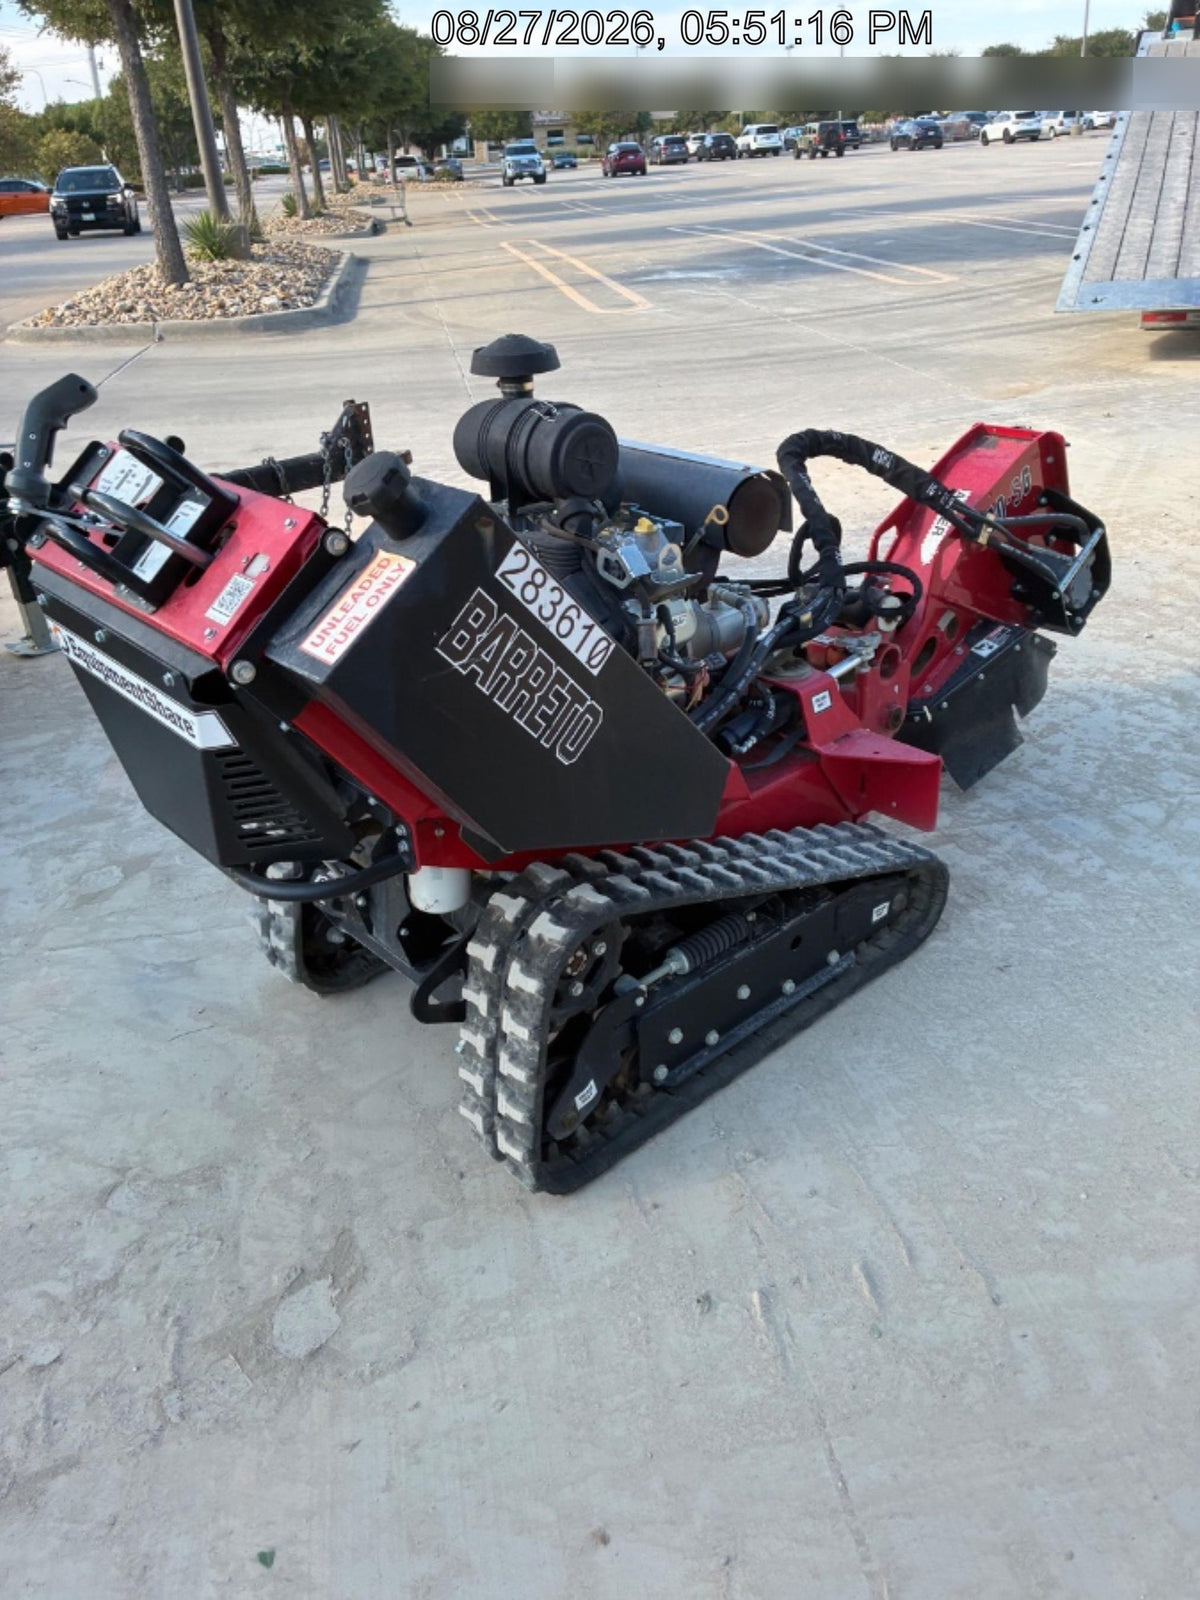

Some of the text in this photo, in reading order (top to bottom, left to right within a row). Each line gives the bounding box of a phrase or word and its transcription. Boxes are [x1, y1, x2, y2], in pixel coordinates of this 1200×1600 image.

[310, 557, 391, 648] UNLEADED
[325, 563, 406, 656] FUEL ONLY
[500, 548, 613, 670] 283610
[434, 586, 603, 765] BARRETO
